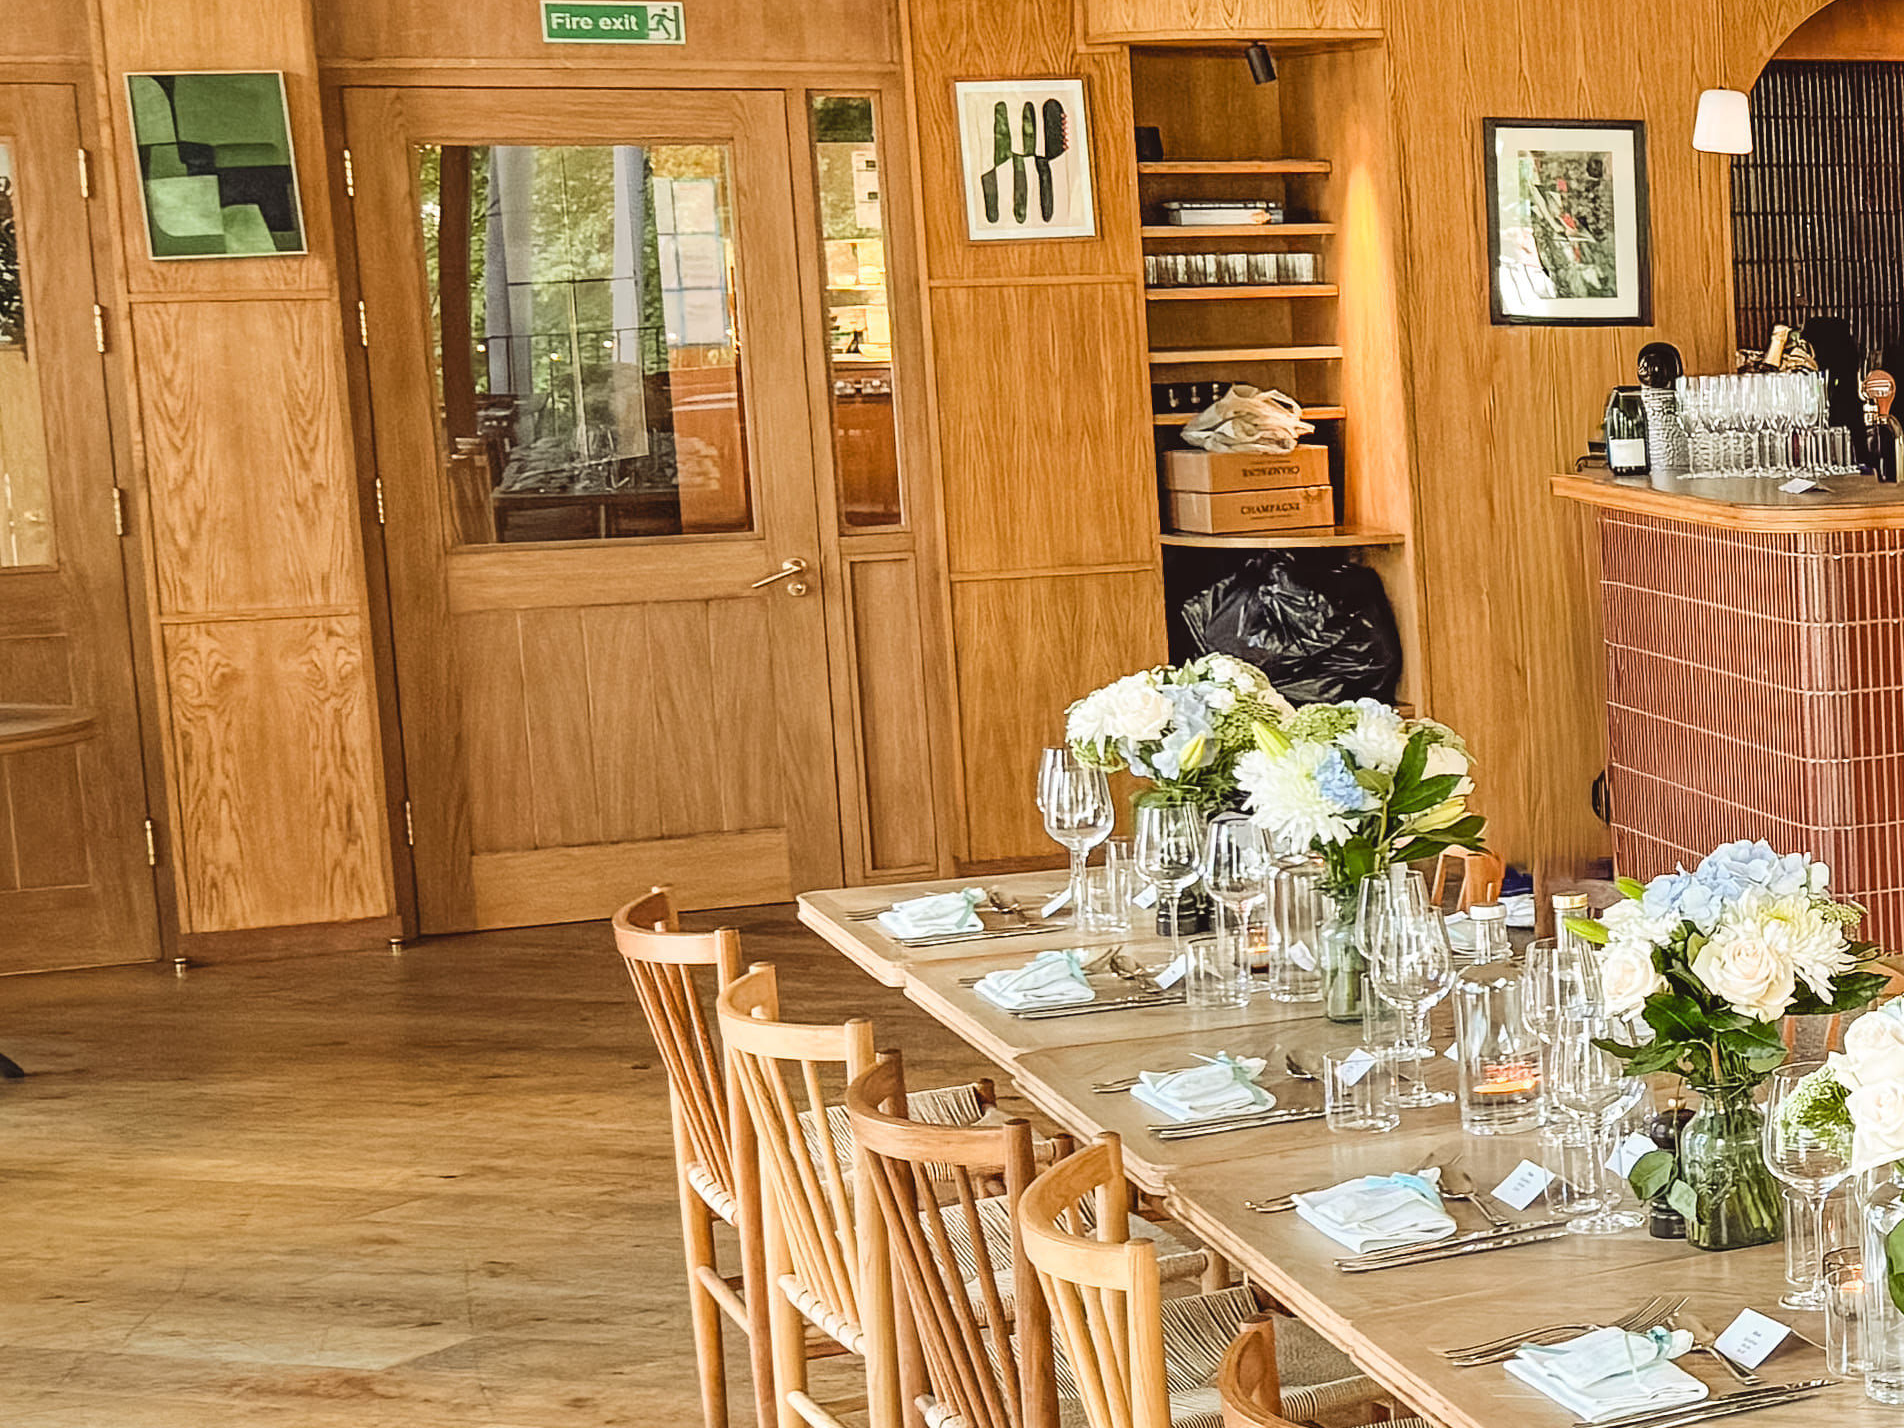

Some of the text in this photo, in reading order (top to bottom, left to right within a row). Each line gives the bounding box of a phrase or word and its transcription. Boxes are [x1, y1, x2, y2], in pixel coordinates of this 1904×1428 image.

[550, 12, 639, 32] Fire exit
[1240, 502, 1301, 515] CHAMPAGNE
